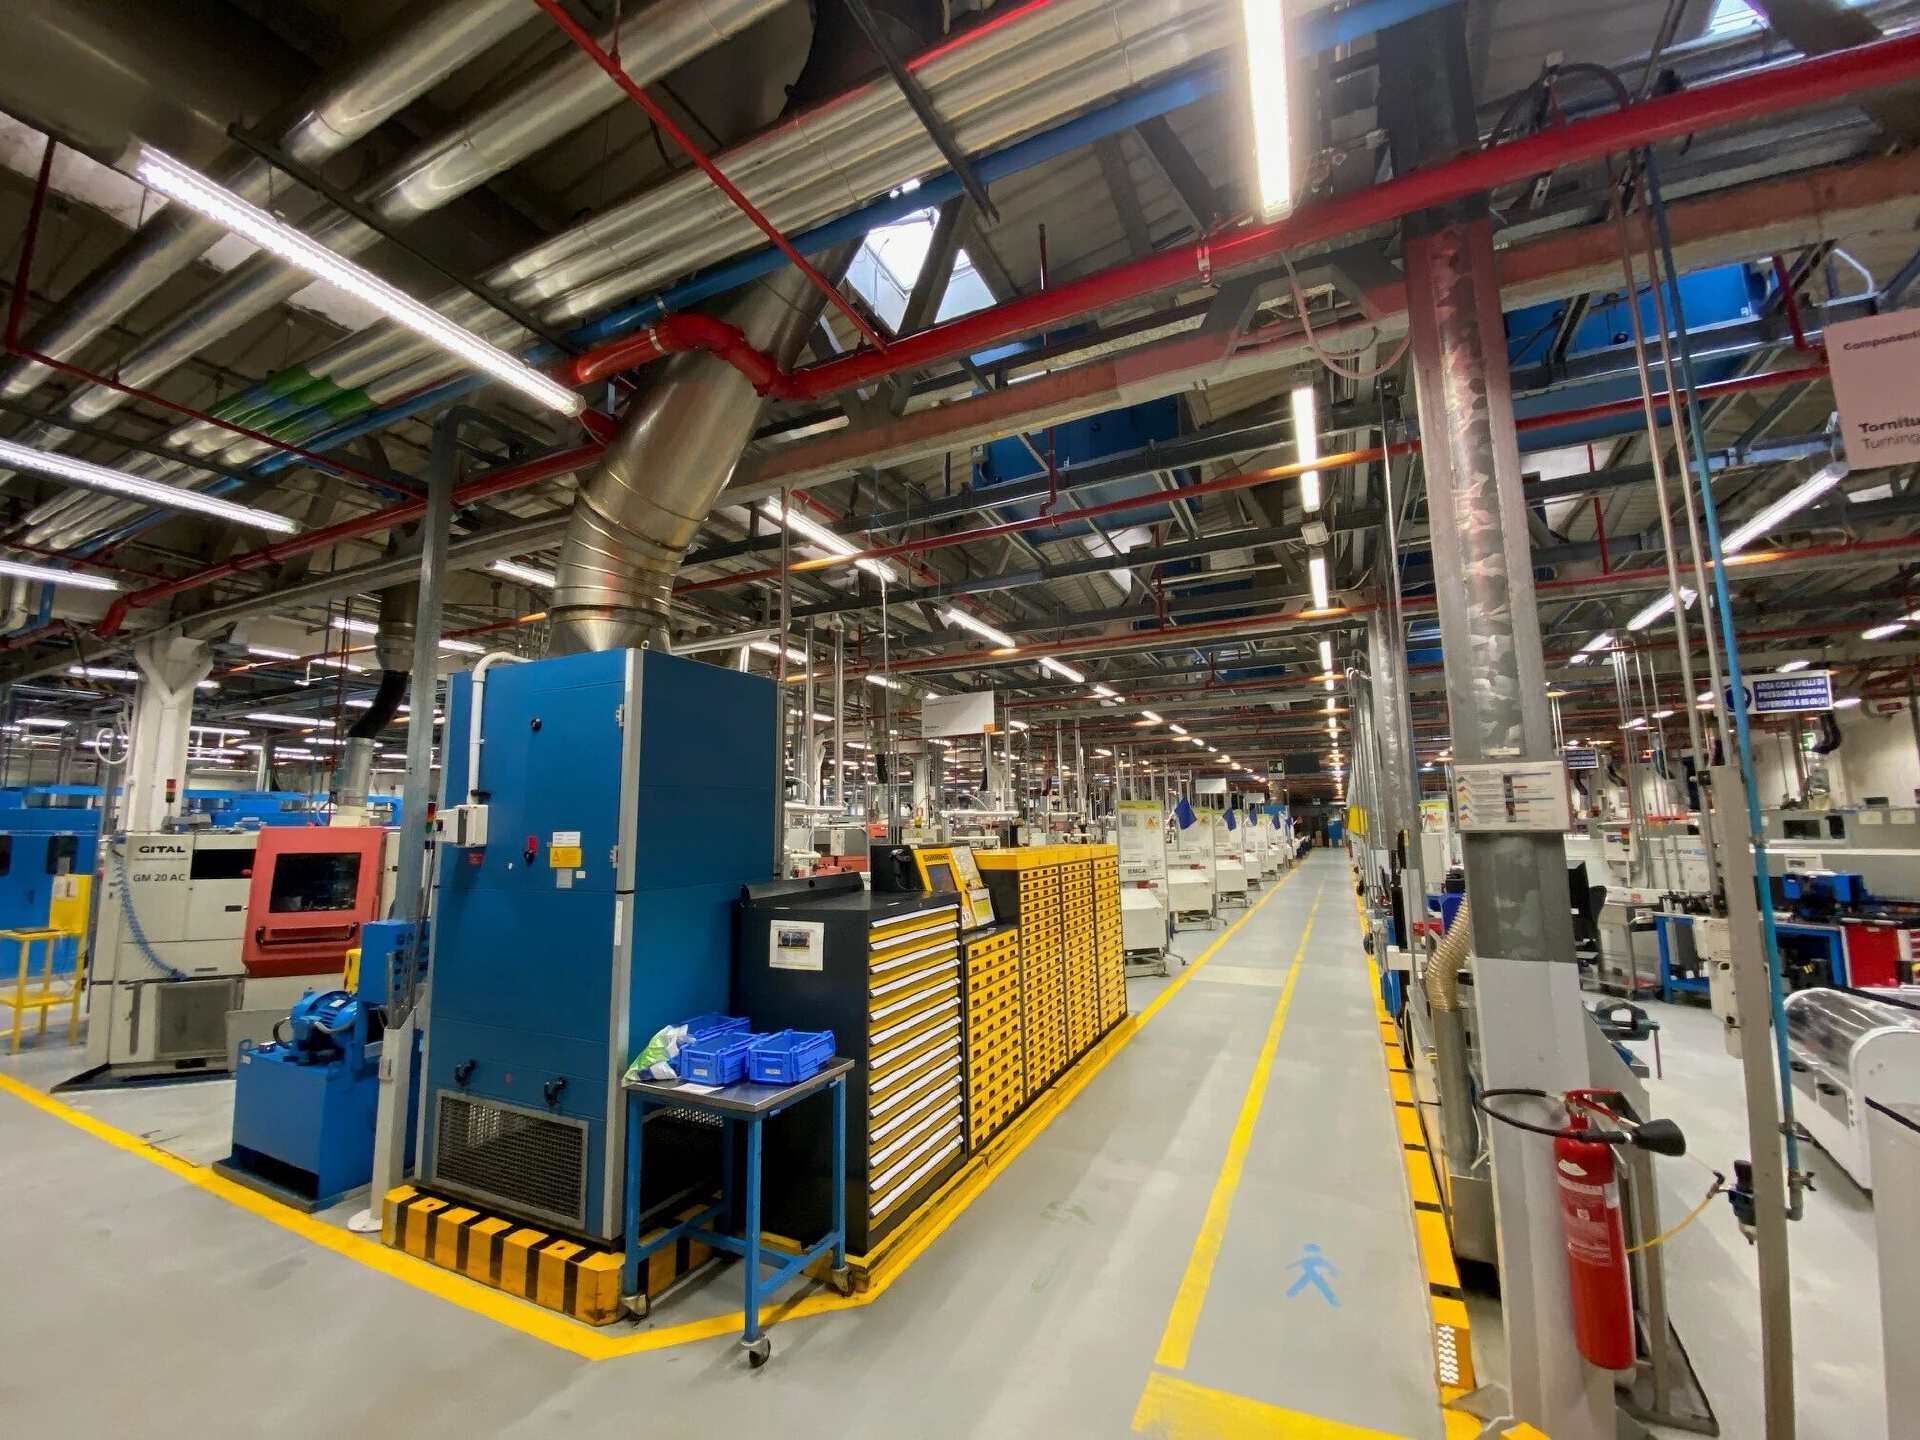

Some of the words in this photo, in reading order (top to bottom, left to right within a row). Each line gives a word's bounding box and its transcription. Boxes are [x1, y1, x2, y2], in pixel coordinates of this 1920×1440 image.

[139, 845, 186, 853] GITAL
[152, 873, 168, 881] 20
[170, 873, 187, 881] AC
